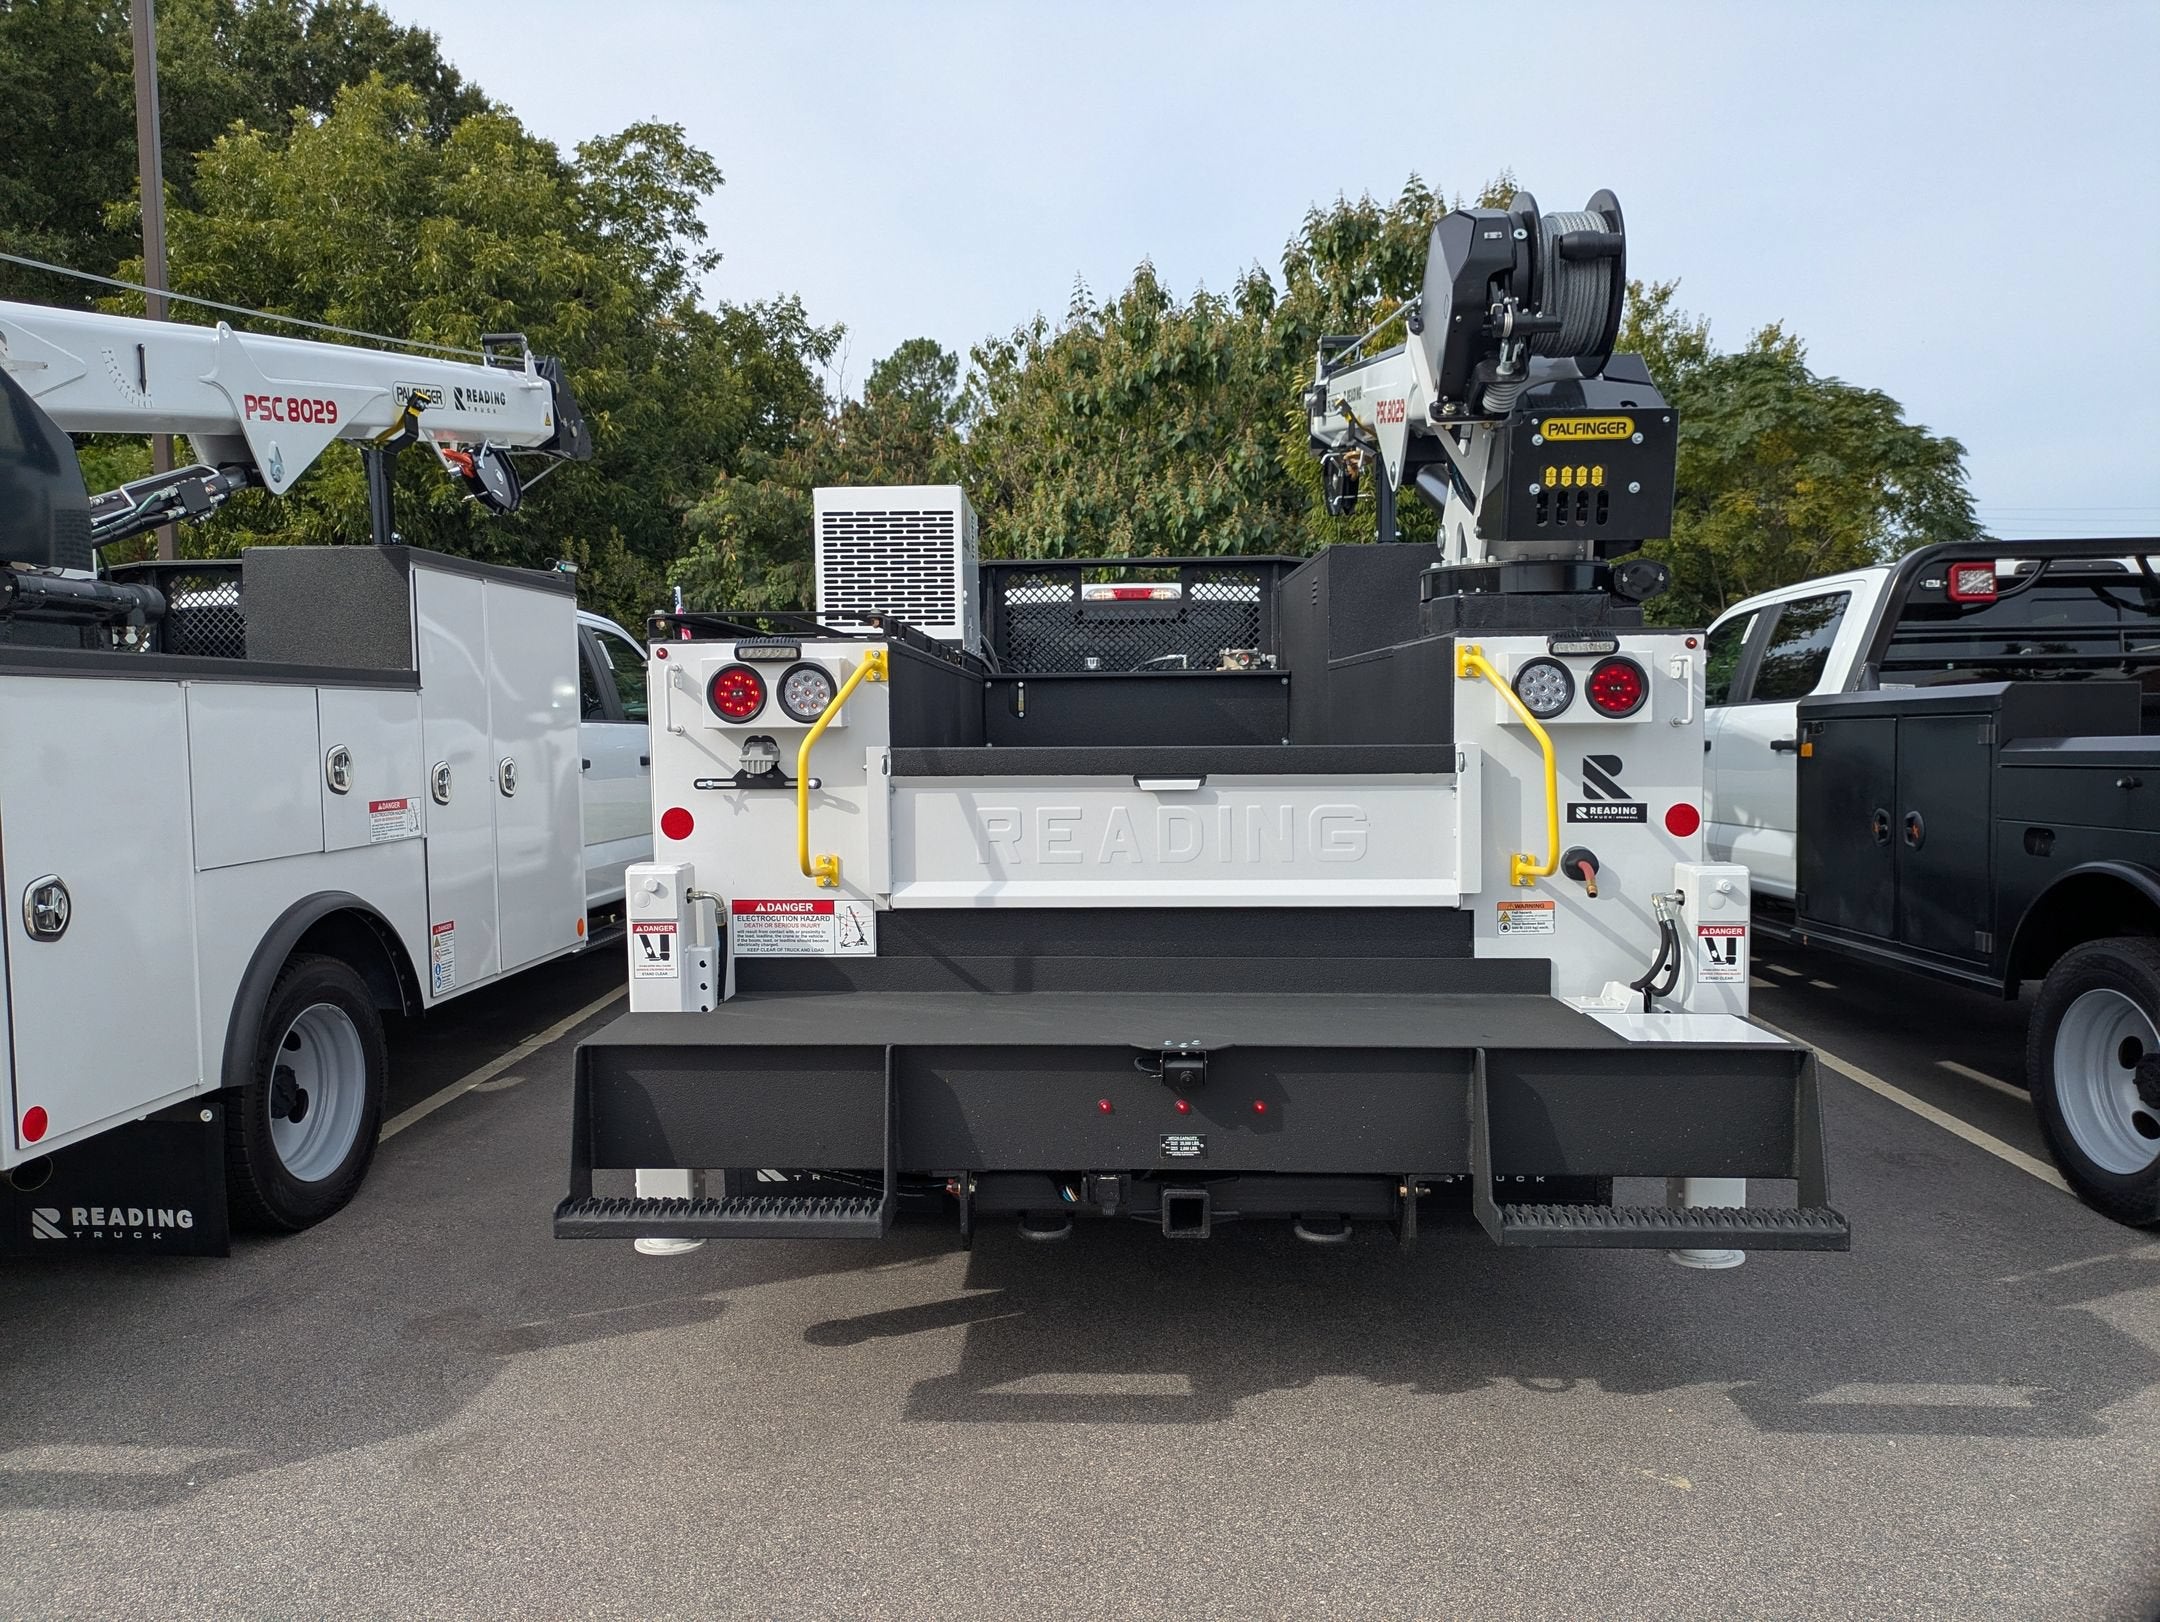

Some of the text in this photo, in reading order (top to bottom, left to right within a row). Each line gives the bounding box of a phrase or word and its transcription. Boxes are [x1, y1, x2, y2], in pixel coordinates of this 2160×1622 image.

[466, 388, 506, 406] READING
[243, 394, 338, 425] PSC 8029
[1548, 422, 1627, 436] PALFINGER
[382, 801, 401, 809] DANGER
[1589, 806, 1638, 815] READING
[976, 804, 1369, 864] READING
[767, 903, 814, 912] DANGER
[1457, 1174, 1545, 1183] TUCK
[71, 1207, 193, 1229] READING
[73, 1231, 162, 1240] TRUCK
